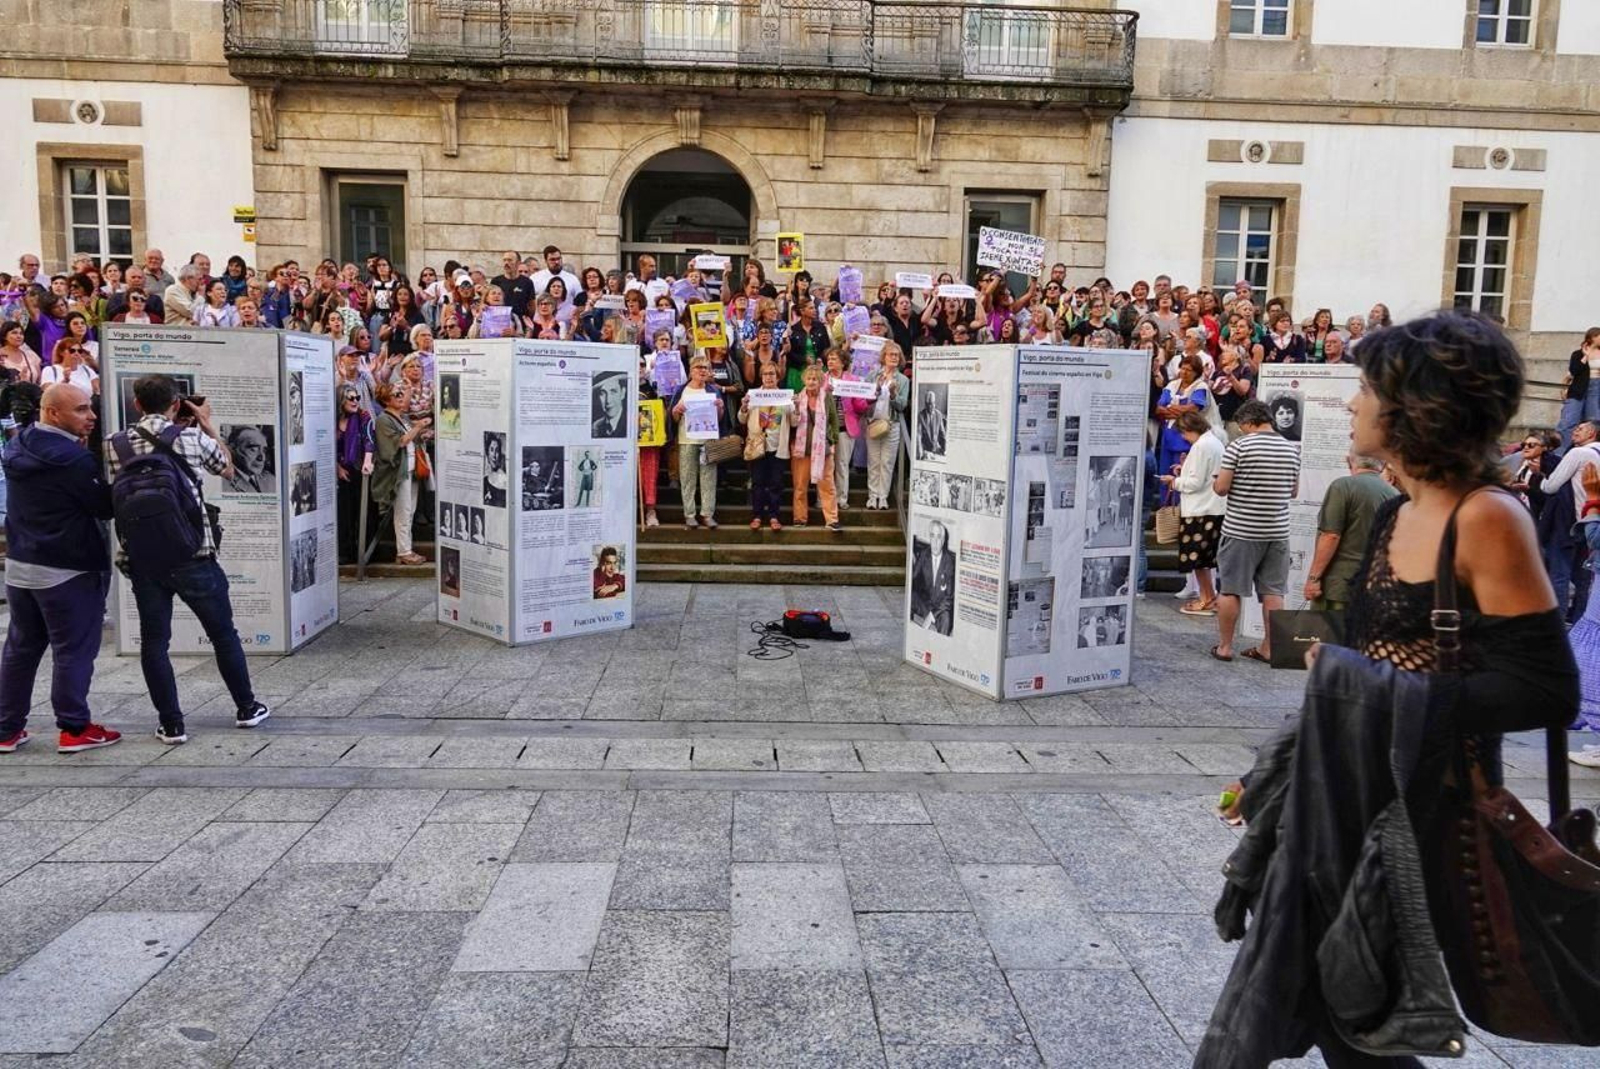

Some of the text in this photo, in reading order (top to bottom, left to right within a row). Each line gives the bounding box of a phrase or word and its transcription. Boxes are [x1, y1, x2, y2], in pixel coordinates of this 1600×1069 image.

[113, 331, 132, 340] Vigo,
[133, 332, 153, 340] porta
[1039, 354, 1054, 362] porta
